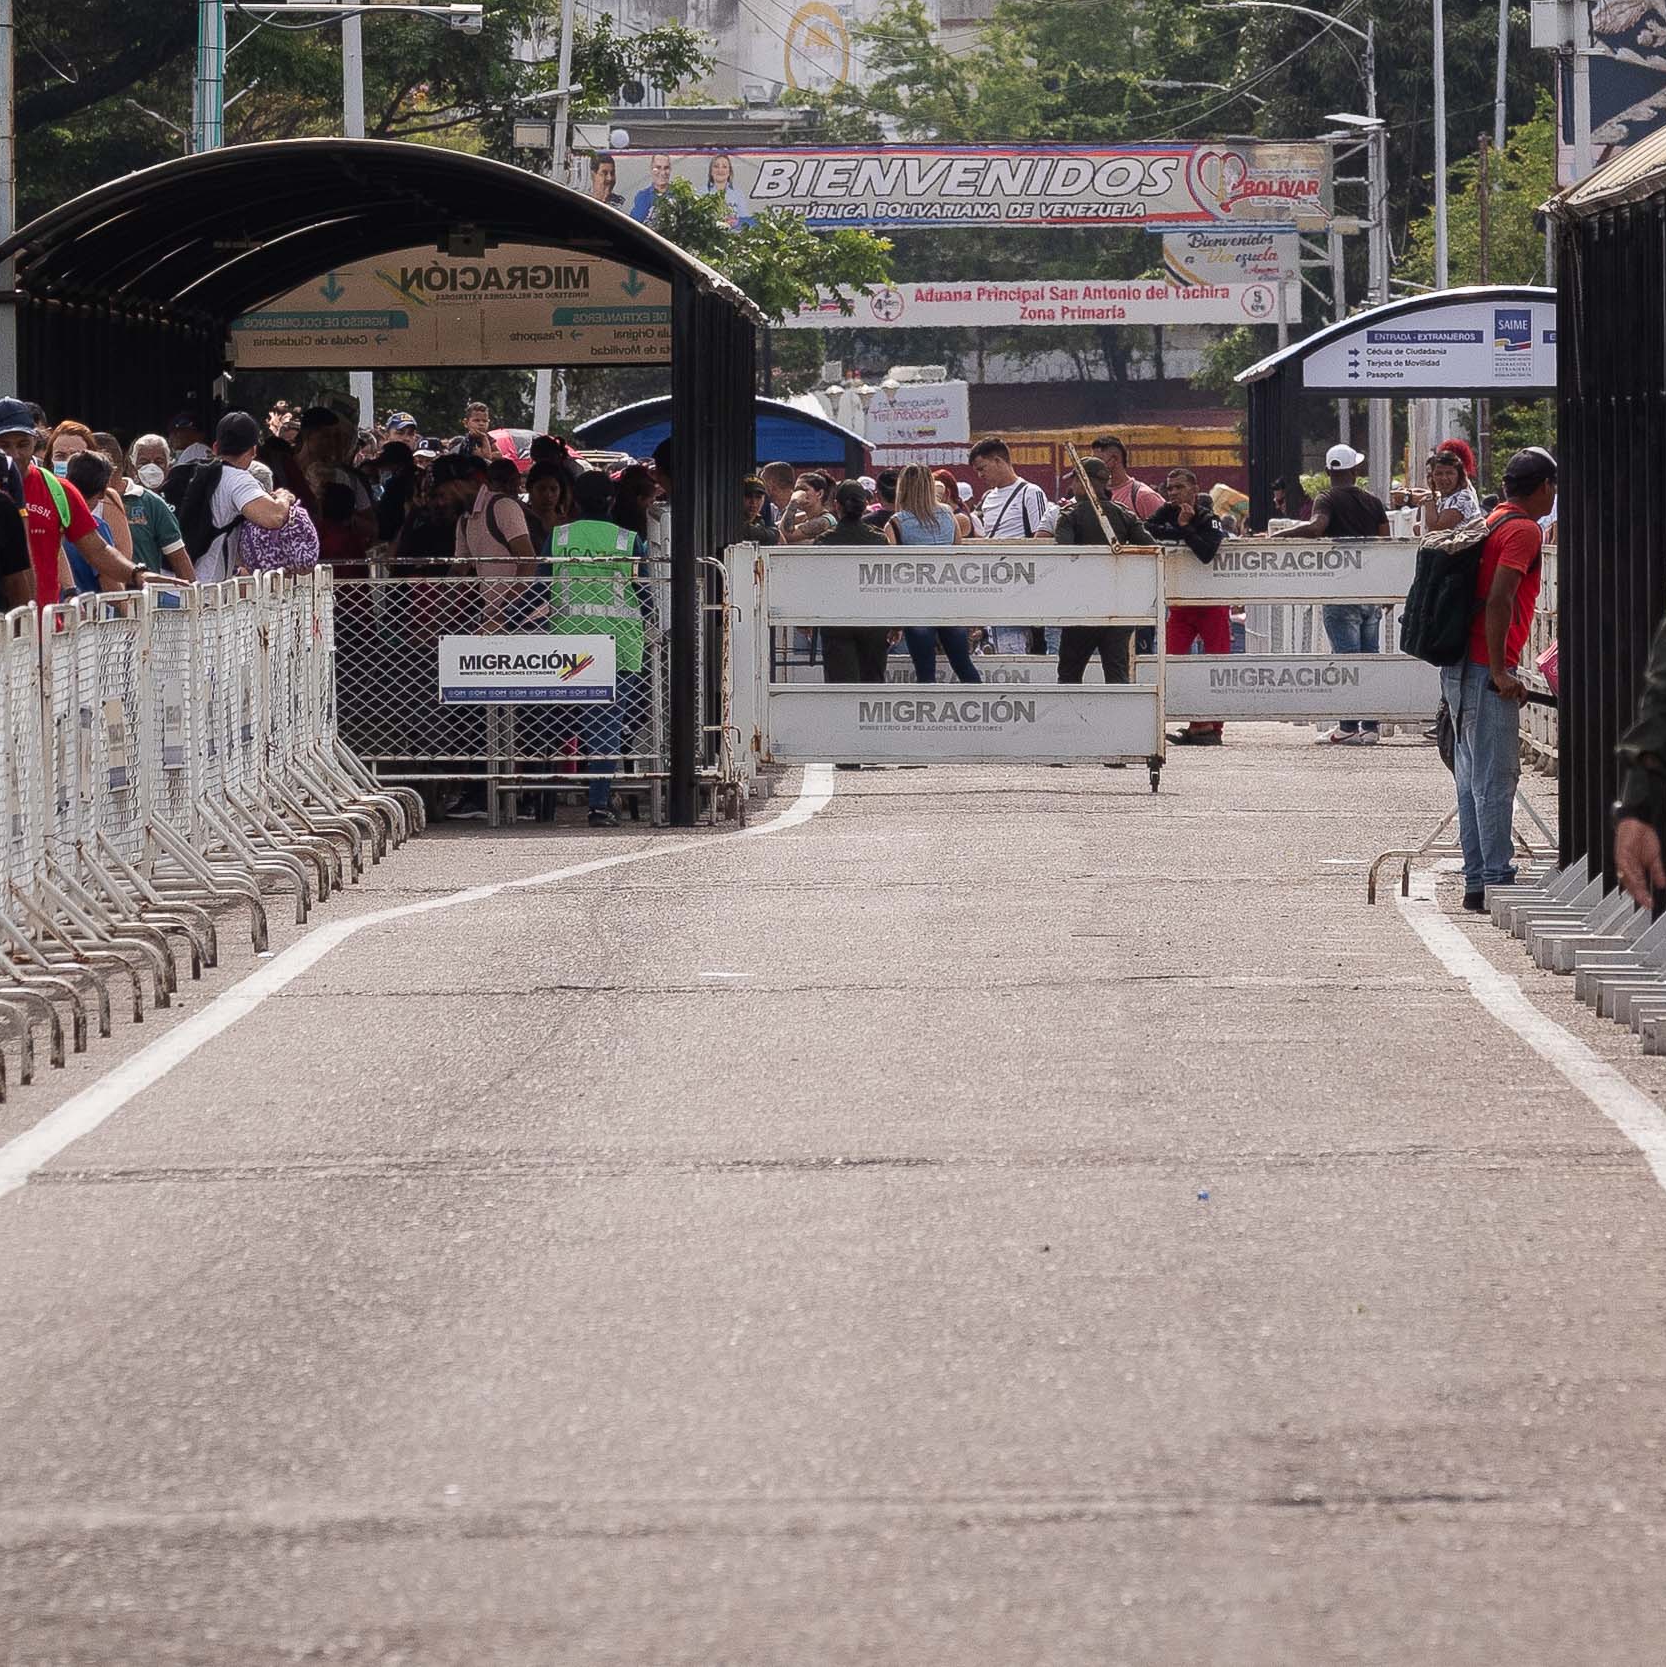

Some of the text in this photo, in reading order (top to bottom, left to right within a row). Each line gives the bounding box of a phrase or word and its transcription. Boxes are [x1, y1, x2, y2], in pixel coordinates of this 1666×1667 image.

[750, 157, 1180, 200] BIENVENIDOS
[873, 202, 1001, 219] BOLIVARIANA
[1006, 202, 1034, 218] DE
[1039, 201, 1146, 218] VENEZUELA
[914, 288, 972, 303] Aduana
[977, 286, 1044, 304] Principal
[1049, 286, 1078, 301] San
[1083, 286, 1141, 301] Antonio
[1145, 285, 1169, 300] del
[1020, 305, 1126, 320] Zona Primaria
[1498, 319, 1528, 331] SAIME
[1374, 333, 1412, 341] ENTRADA
[1417, 333, 1476, 341] EXTRANJEROS
[1366, 360, 1393, 368] Tarjeta
[1405, 359, 1440, 367] Movilidad
[1366, 371, 1404, 380] Pasaporte
[1213, 546, 1362, 571] MIGRACIÓN
[859, 556, 1035, 585] MIGRACIÓN
[459, 650, 577, 670] MIGRACIÓN
[1210, 662, 1359, 687] MIGRACIÓN
[859, 695, 1035, 723] MIGRACIÓN
